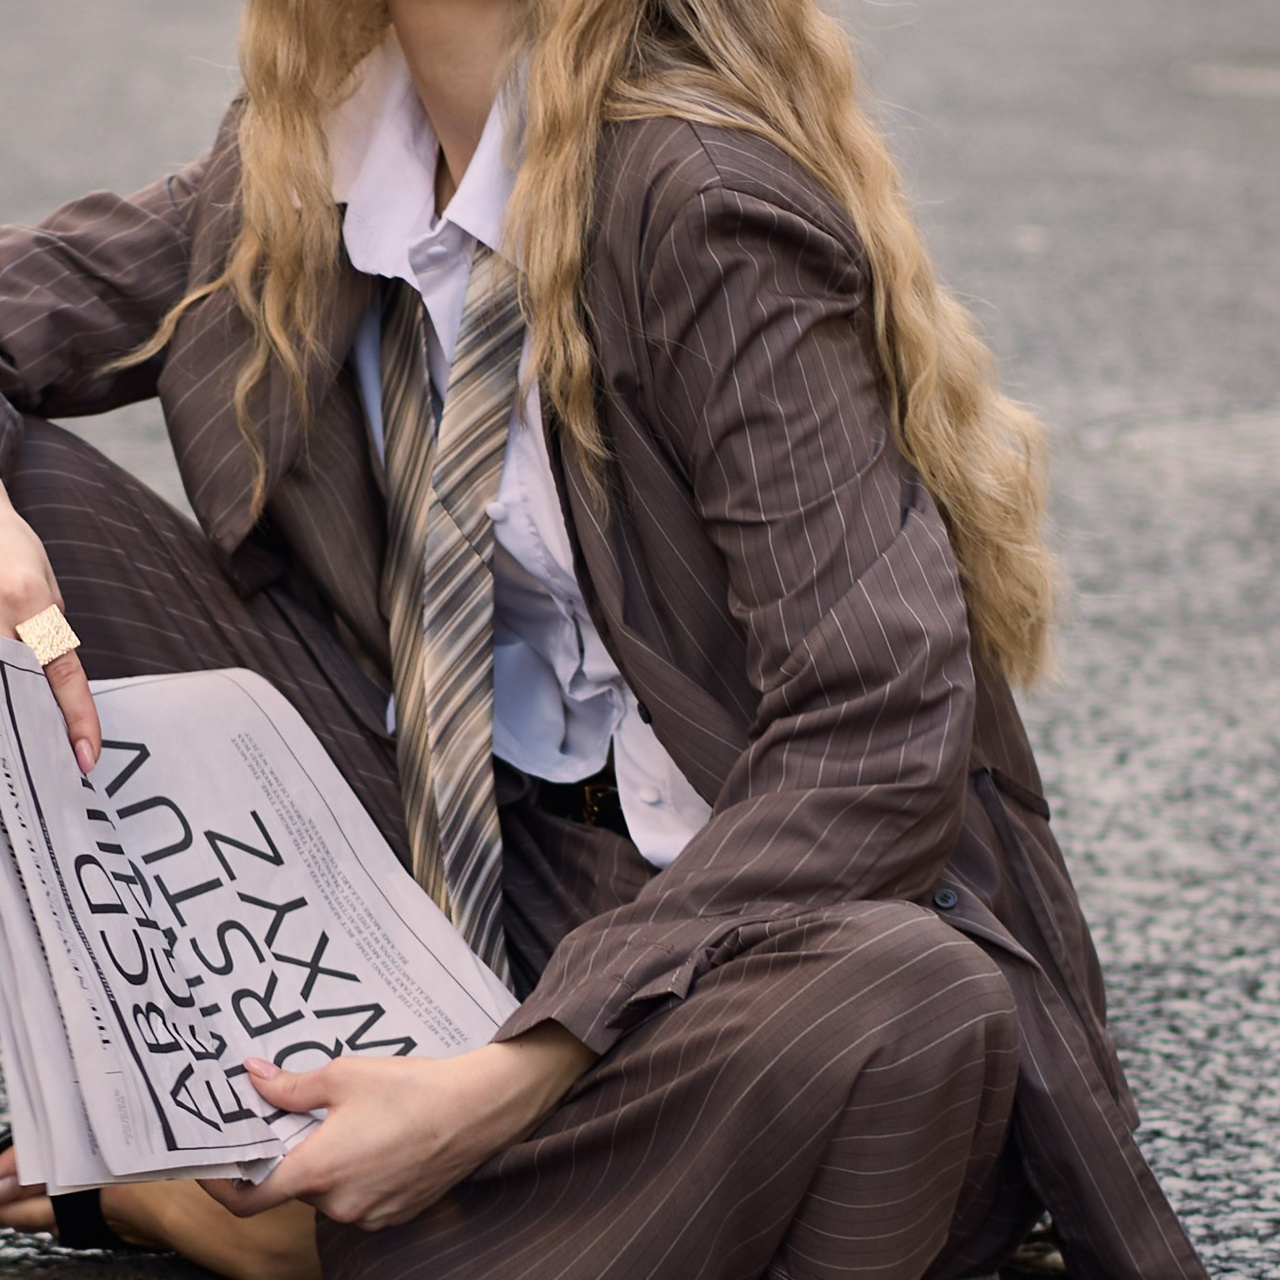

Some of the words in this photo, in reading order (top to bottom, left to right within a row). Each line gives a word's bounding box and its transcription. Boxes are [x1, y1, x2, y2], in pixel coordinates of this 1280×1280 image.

[229, 736, 250, 762] MOST
[235, 732, 252, 751] WAS
[242, 730, 261, 752] JUST
[246, 762, 262, 780] THE
[247, 751, 275, 787] WOUND
[270, 787, 298, 826] DEEPEST
[286, 798, 307, 826] GREW
[273, 807, 295, 836] RIGHT
[291, 837, 306, 855] THE
[294, 827, 309, 845] THE
[318, 855, 345, 893] CHANGE
[308, 870, 342, 920] SEPARATED
[335, 870, 365, 905] CLEARLY
[24, 839, 89, 989] NEWSPAPER
[327, 887, 363, 934] BEAUTIFUL
[341, 894, 358, 911] NOT
[338, 920, 356, 938] BUT
[355, 913, 372, 930] DID
[361, 907, 383, 931] MORE
[203, 810, 417, 1057] WXYZ
[361, 936, 381, 958] MOST
[379, 932, 409, 965] BECAME
[370, 962, 399, 992] WRONG
[379, 960, 396, 975] THE
[74, 854, 223, 1133] ABCD
[394, 976, 414, 995] TAKE
[415, 986, 435, 1004] REAL
[396, 992, 414, 1007] THE
[88, 999, 112, 1050] THE
[422, 1018, 440, 1035] MET
[432, 1004, 455, 1026] MOST
[429, 1014, 462, 1045] URGENT
[451, 1026, 470, 1042] THE
